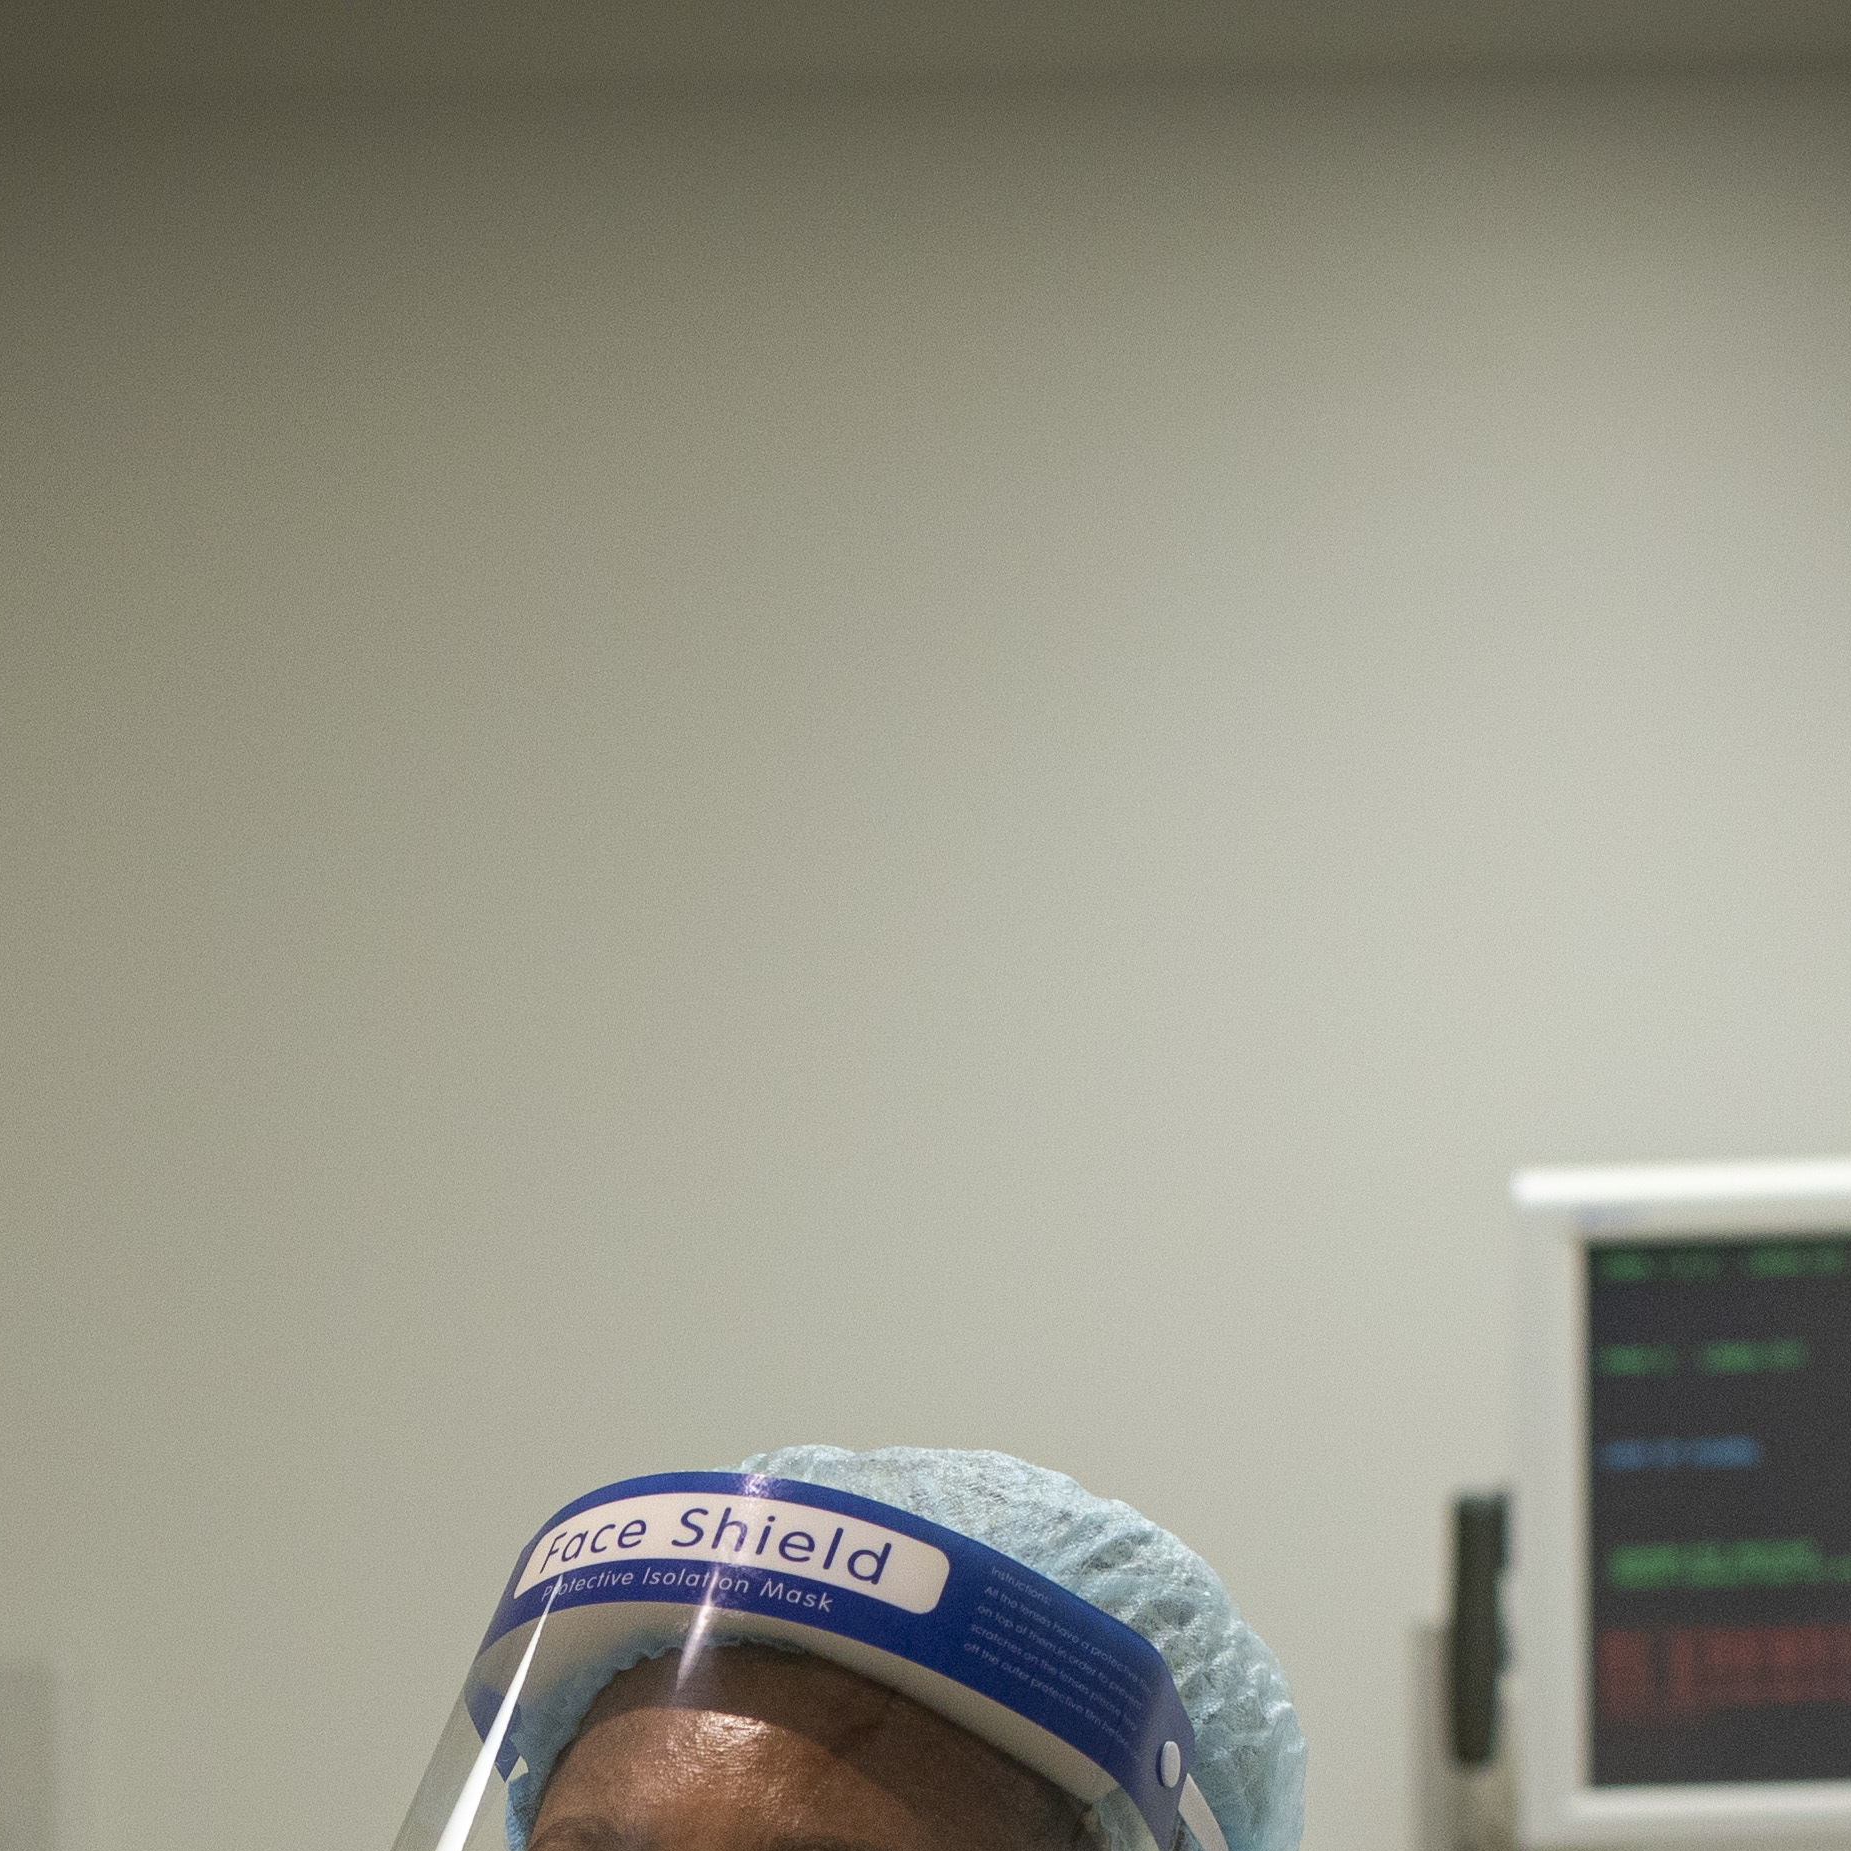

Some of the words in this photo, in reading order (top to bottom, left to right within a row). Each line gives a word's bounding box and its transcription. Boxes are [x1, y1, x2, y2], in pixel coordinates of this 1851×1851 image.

[539, 1518, 647, 1574] Face
[671, 1507, 892, 1585] Shield
[760, 1578, 833, 1613] Mask
